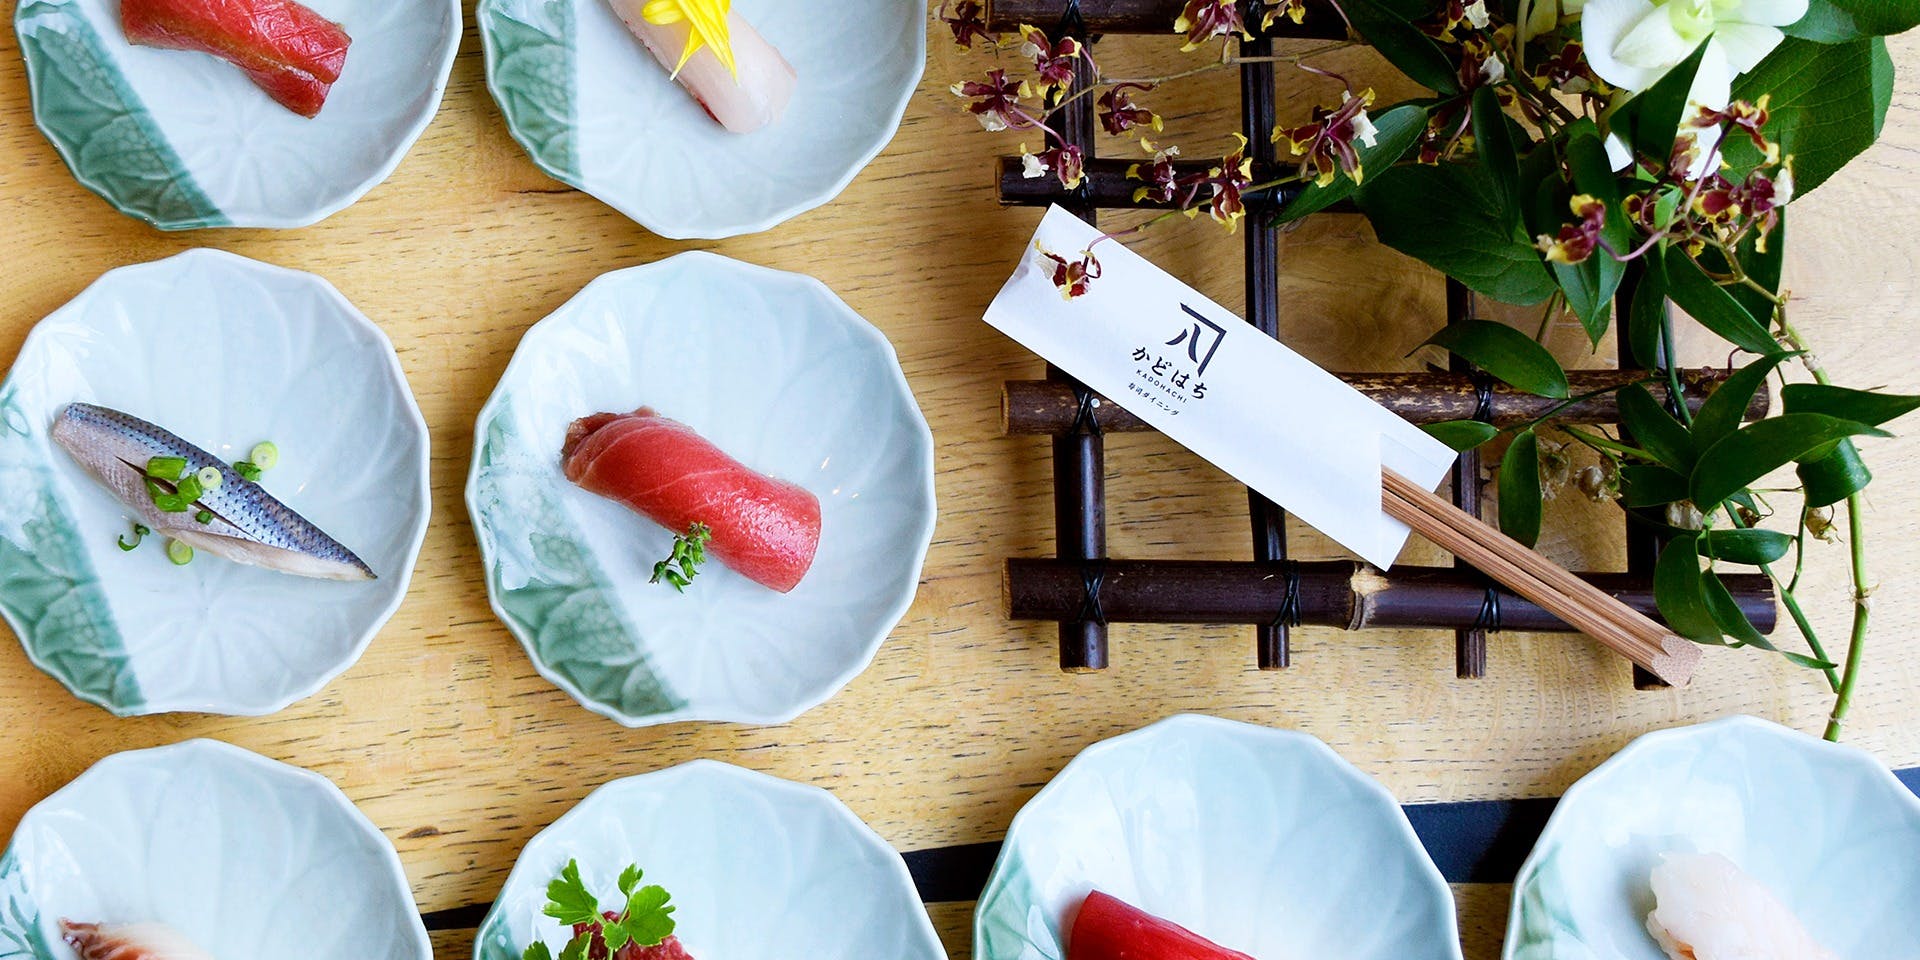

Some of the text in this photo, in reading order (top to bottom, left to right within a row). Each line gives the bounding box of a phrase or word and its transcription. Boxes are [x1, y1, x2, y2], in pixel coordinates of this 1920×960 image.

[1132, 347, 1208, 400] かどはち
[1136, 369, 1188, 404] KADOHACHI
